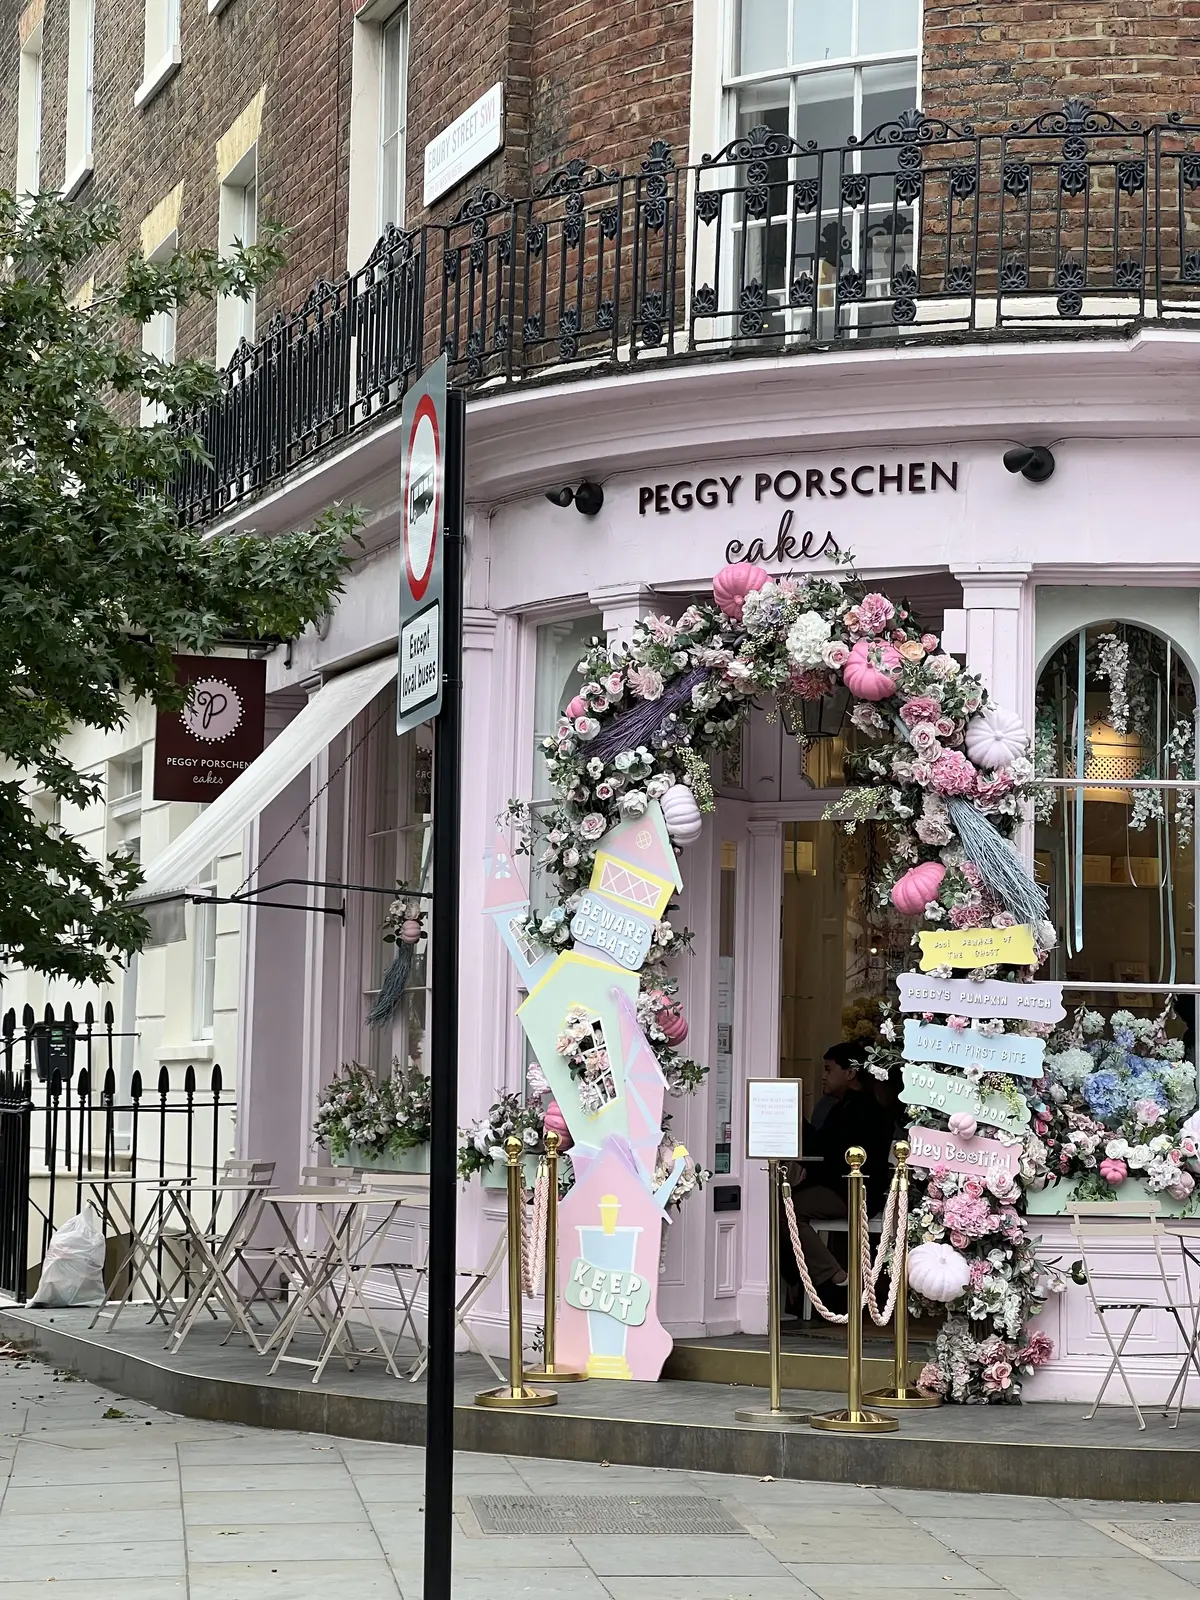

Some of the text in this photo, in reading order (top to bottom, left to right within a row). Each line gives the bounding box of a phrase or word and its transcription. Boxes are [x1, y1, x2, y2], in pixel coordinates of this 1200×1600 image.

[427, 96, 495, 174] EBURY STREET SW1
[638, 461, 958, 515] PEGGY PORSCHEN
[725, 509, 839, 564] cakes
[409, 623, 431, 660] Except
[402, 659, 436, 698] local buses
[166, 757, 252, 769] PEGGY PORSCHEN
[192, 770, 224, 784] cakes
[580, 897, 647, 945] BEWARE
[573, 917, 641, 966] OF BATS
[947, 948, 1000, 959] THE GHOST
[961, 937, 994, 947] BEWARE
[908, 988, 1052, 1009] PEGGY'S PUMPKIN PATCH
[916, 1035, 1028, 1064] LOVE AT FIRST BITE
[910, 1072, 936, 1089] TOO
[928, 1091, 946, 1107] TO
[911, 1135, 942, 1161] Hey
[573, 1260, 642, 1297] KEEP
[578, 1286, 632, 1321] OUT
